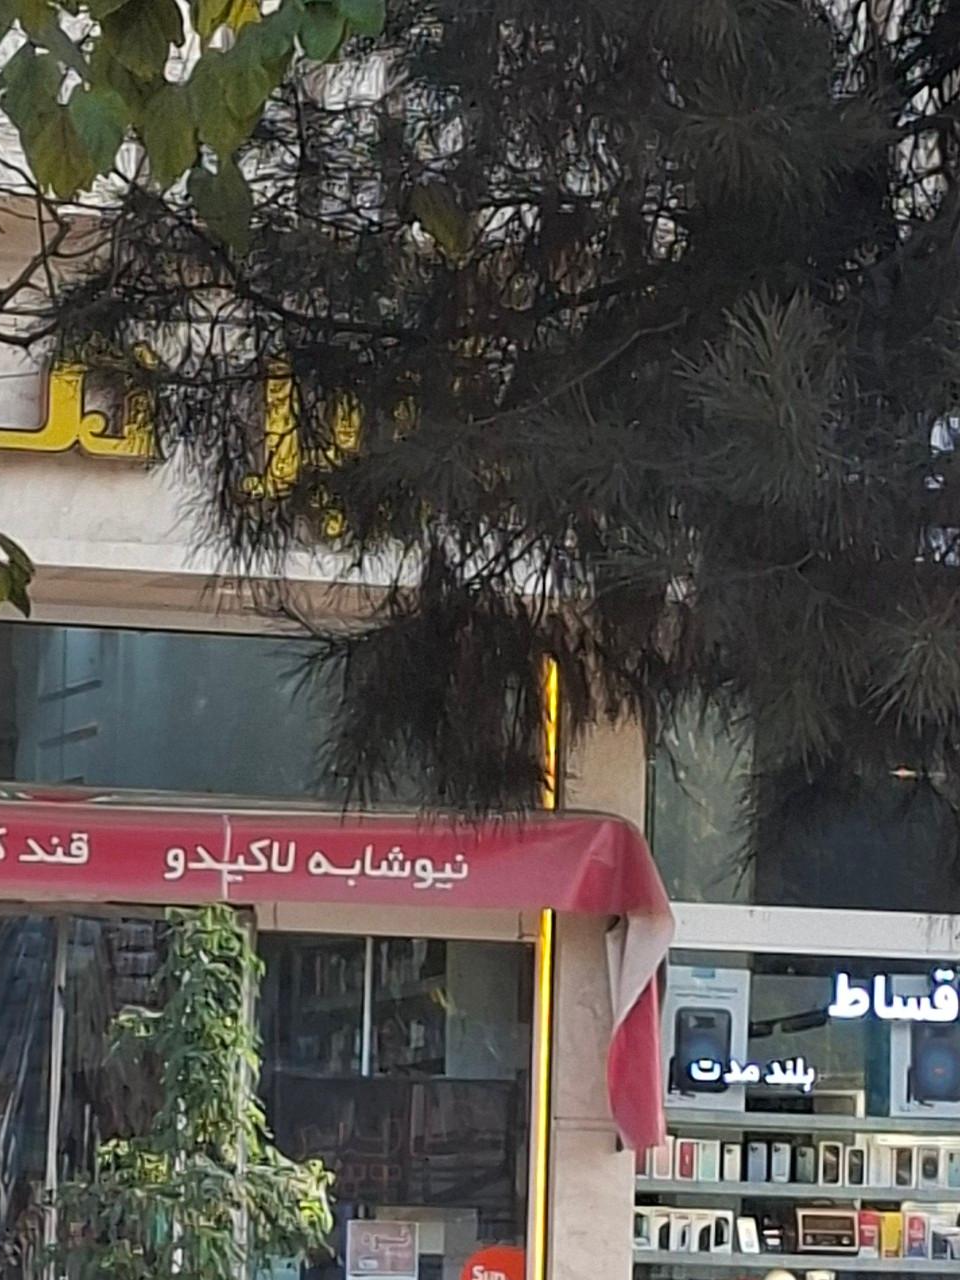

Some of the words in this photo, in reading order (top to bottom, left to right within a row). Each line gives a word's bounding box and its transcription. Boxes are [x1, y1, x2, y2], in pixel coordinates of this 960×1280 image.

[18, 832, 89, 865] قند
[163, 838, 296, 882] لاکیدو
[307, 844, 469, 889] نیوشابه
[828, 968, 959, 1022] قساط
[690, 1058, 761, 1084] مدت
[764, 1056, 815, 1093] بلند
